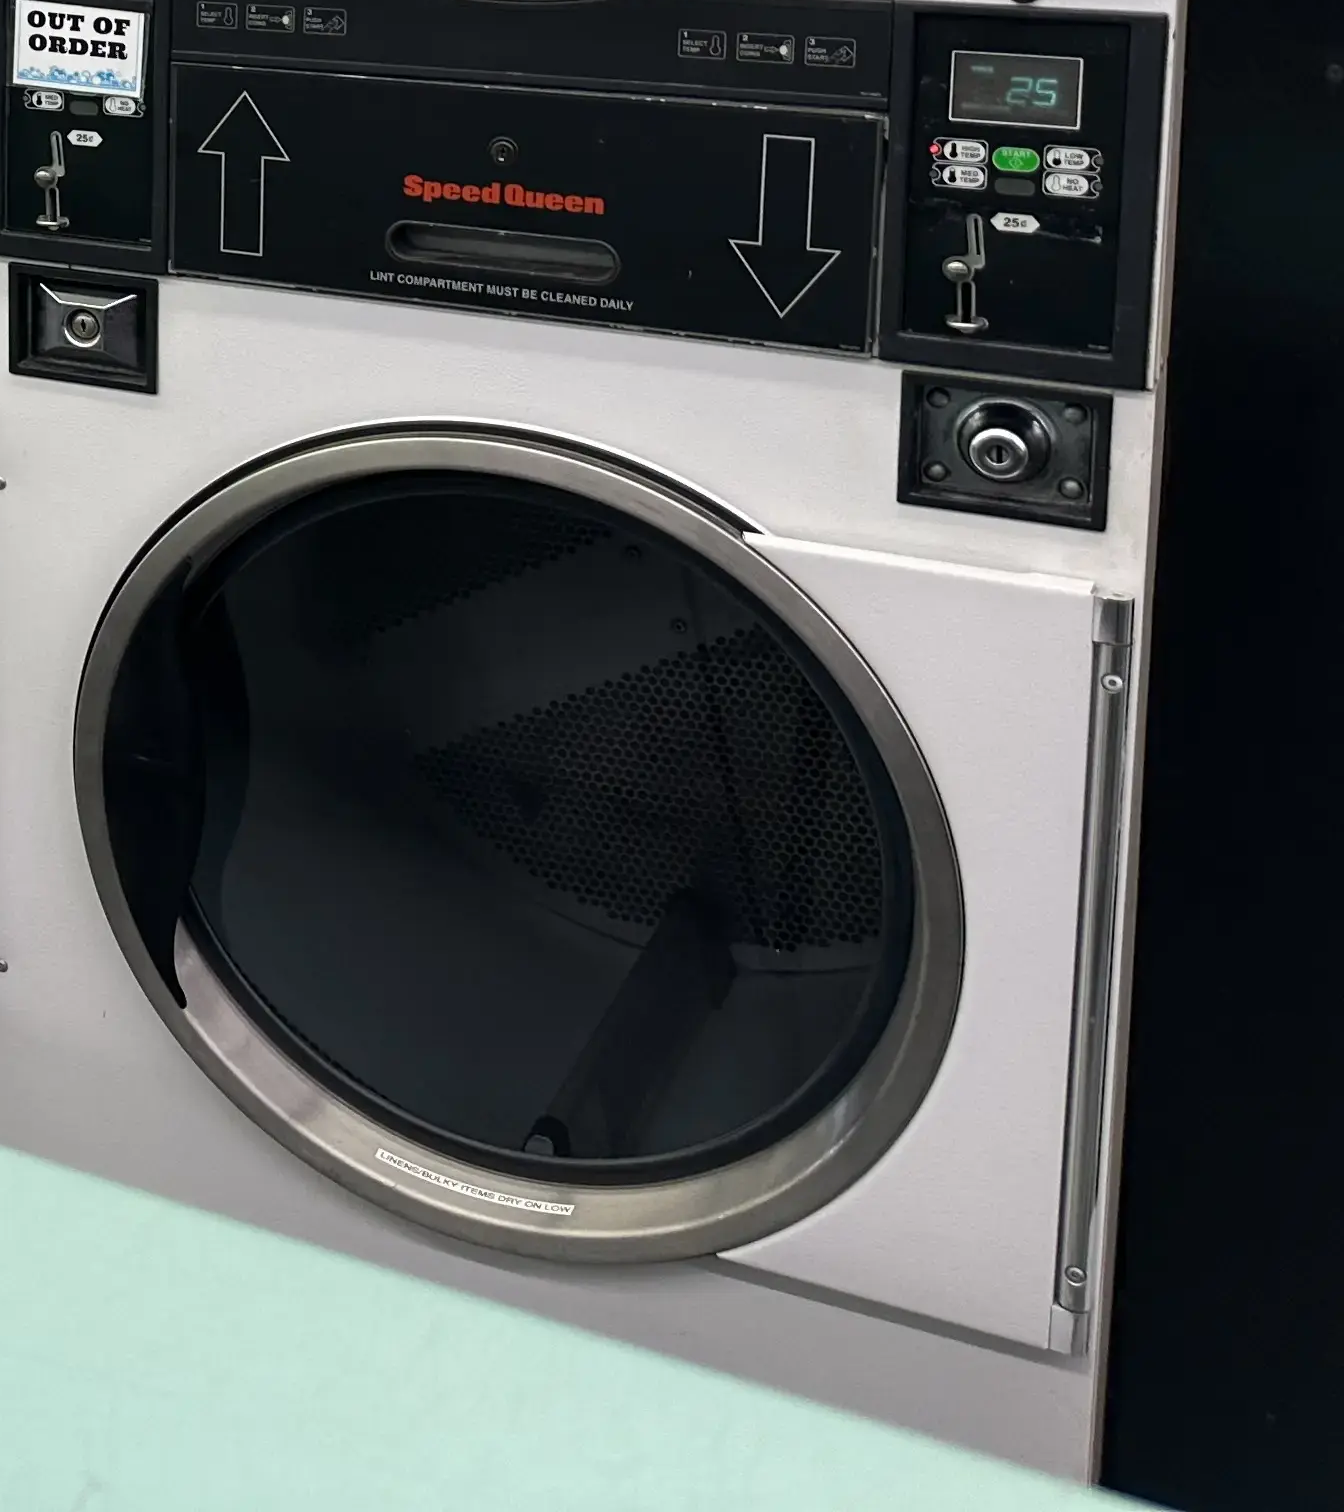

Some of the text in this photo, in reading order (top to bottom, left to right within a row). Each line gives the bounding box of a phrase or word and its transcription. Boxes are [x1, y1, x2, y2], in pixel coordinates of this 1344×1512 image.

[27, 10, 130, 36] OUT OF
[29, 34, 128, 60] ORDER
[1006, 77, 1058, 107] 25
[1002, 150, 1031, 158] START
[403, 174, 604, 215] Speed Queen
[1003, 217, 1027, 228] 25¢
[370, 270, 633, 311] LINT COMPARTMENT MUST BE CLEANED DAILY
[380, 1152, 571, 1213] LINENS/BULKY ITEMS DRY ON LOW
